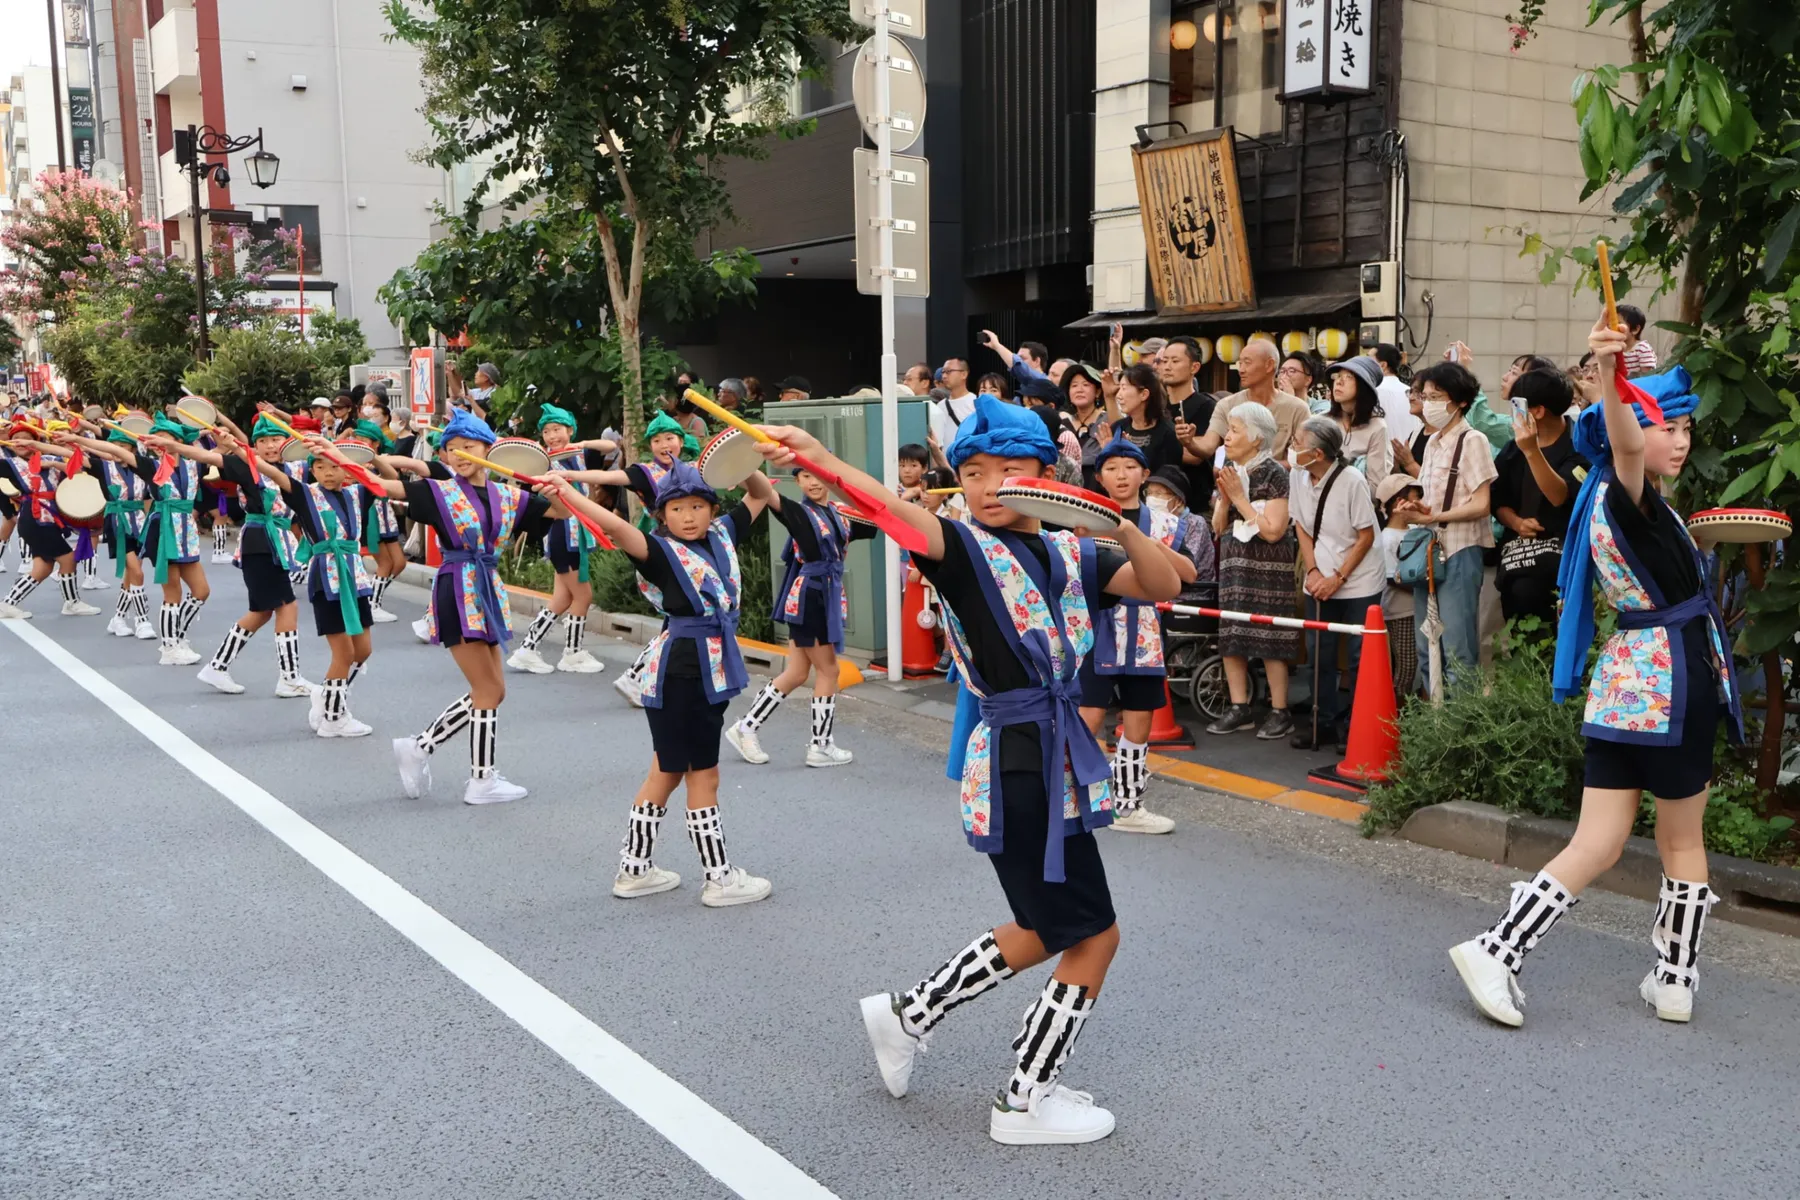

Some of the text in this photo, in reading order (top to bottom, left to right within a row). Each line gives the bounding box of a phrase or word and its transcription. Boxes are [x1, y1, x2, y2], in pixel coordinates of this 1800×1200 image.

[1334, 0, 1363, 77] 焼き
[72, 105, 92, 118] 24
[1209, 152, 1228, 223] 串屋横丁
[1154, 208, 1175, 301] 浅草国際通り店
[1505, 558, 1536, 571] SINCE 1876
